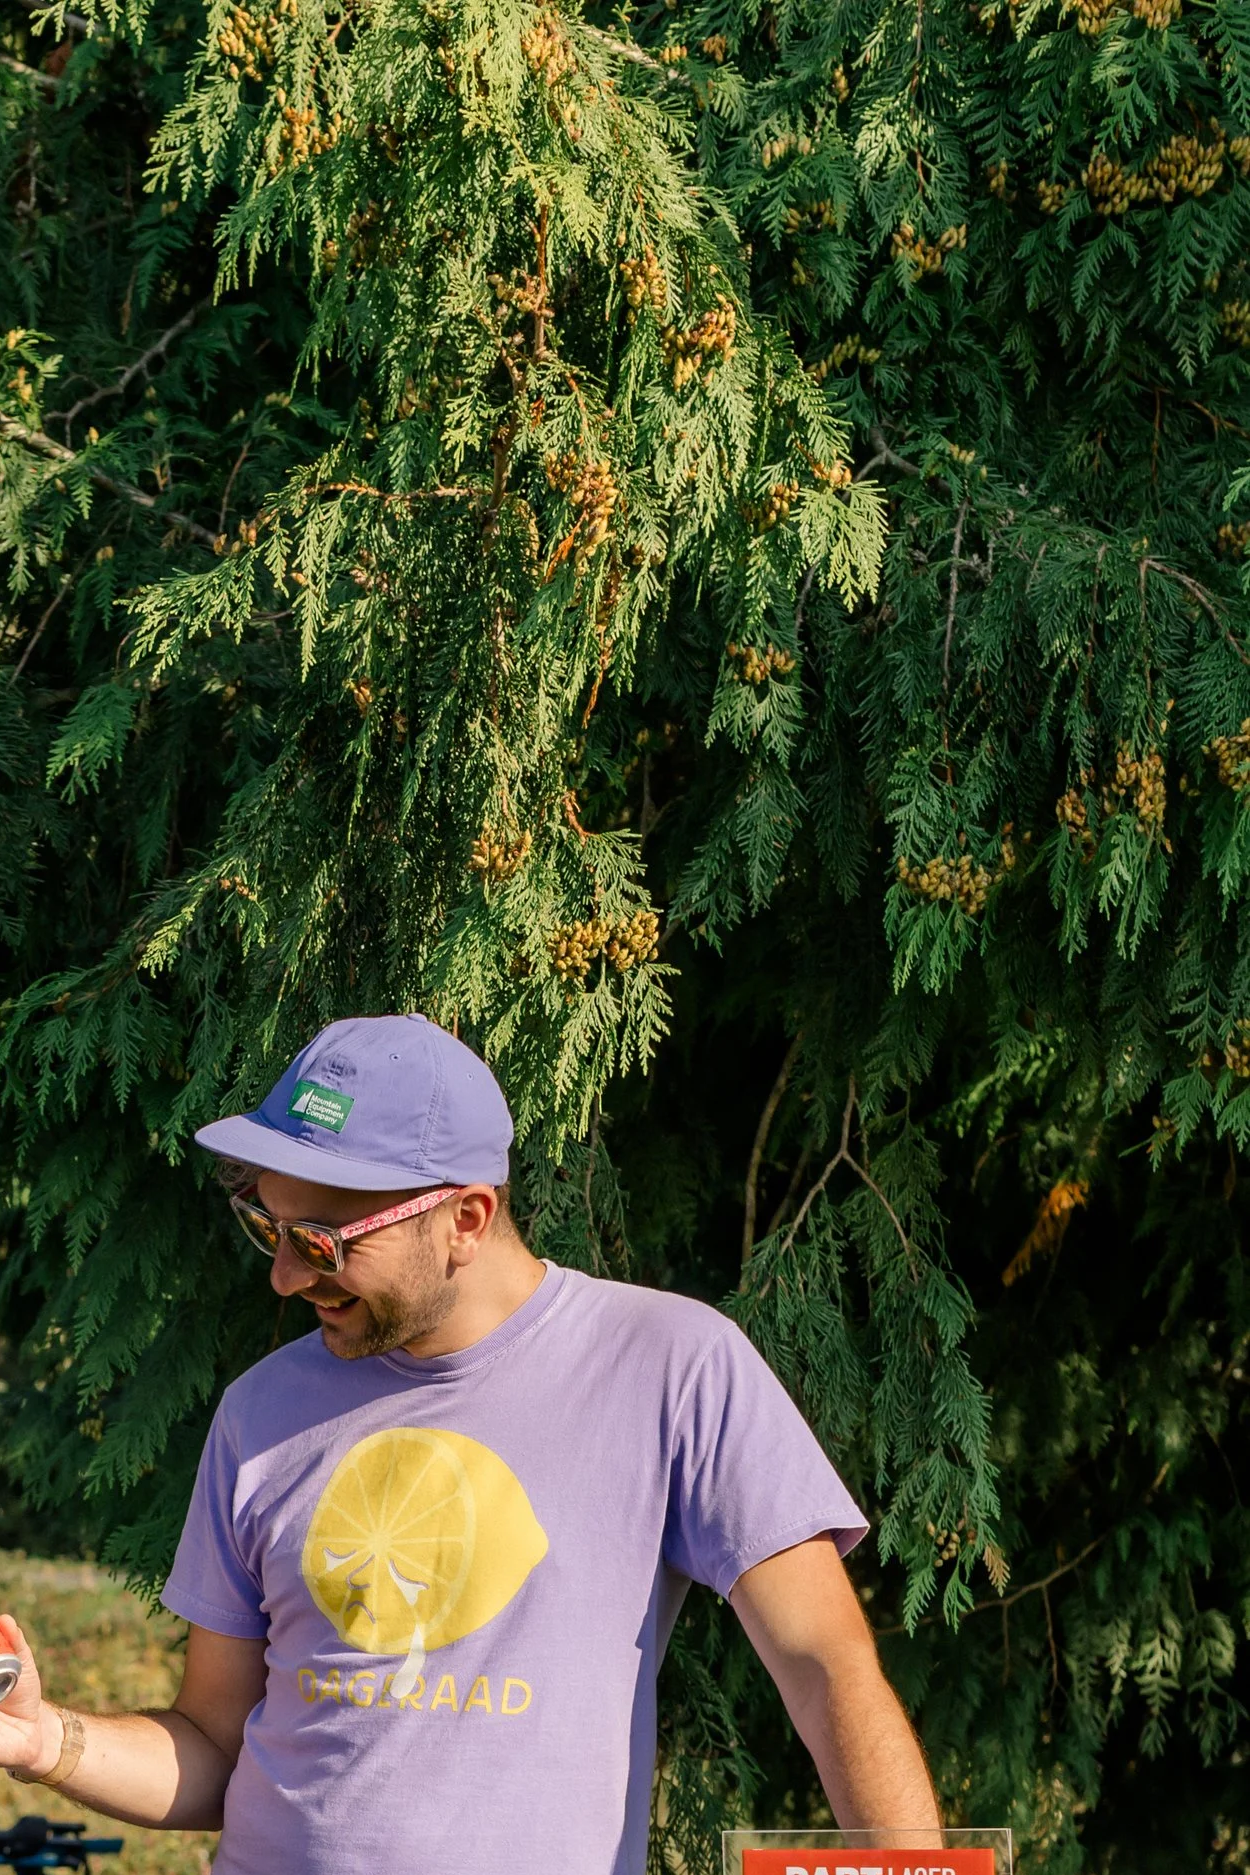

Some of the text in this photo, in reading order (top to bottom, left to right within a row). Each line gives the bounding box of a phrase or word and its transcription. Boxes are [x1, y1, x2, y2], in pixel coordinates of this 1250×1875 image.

[308, 1101, 344, 1119] Equipment
[311, 1095, 341, 1111] Mountain
[306, 1108, 337, 1125] Company
